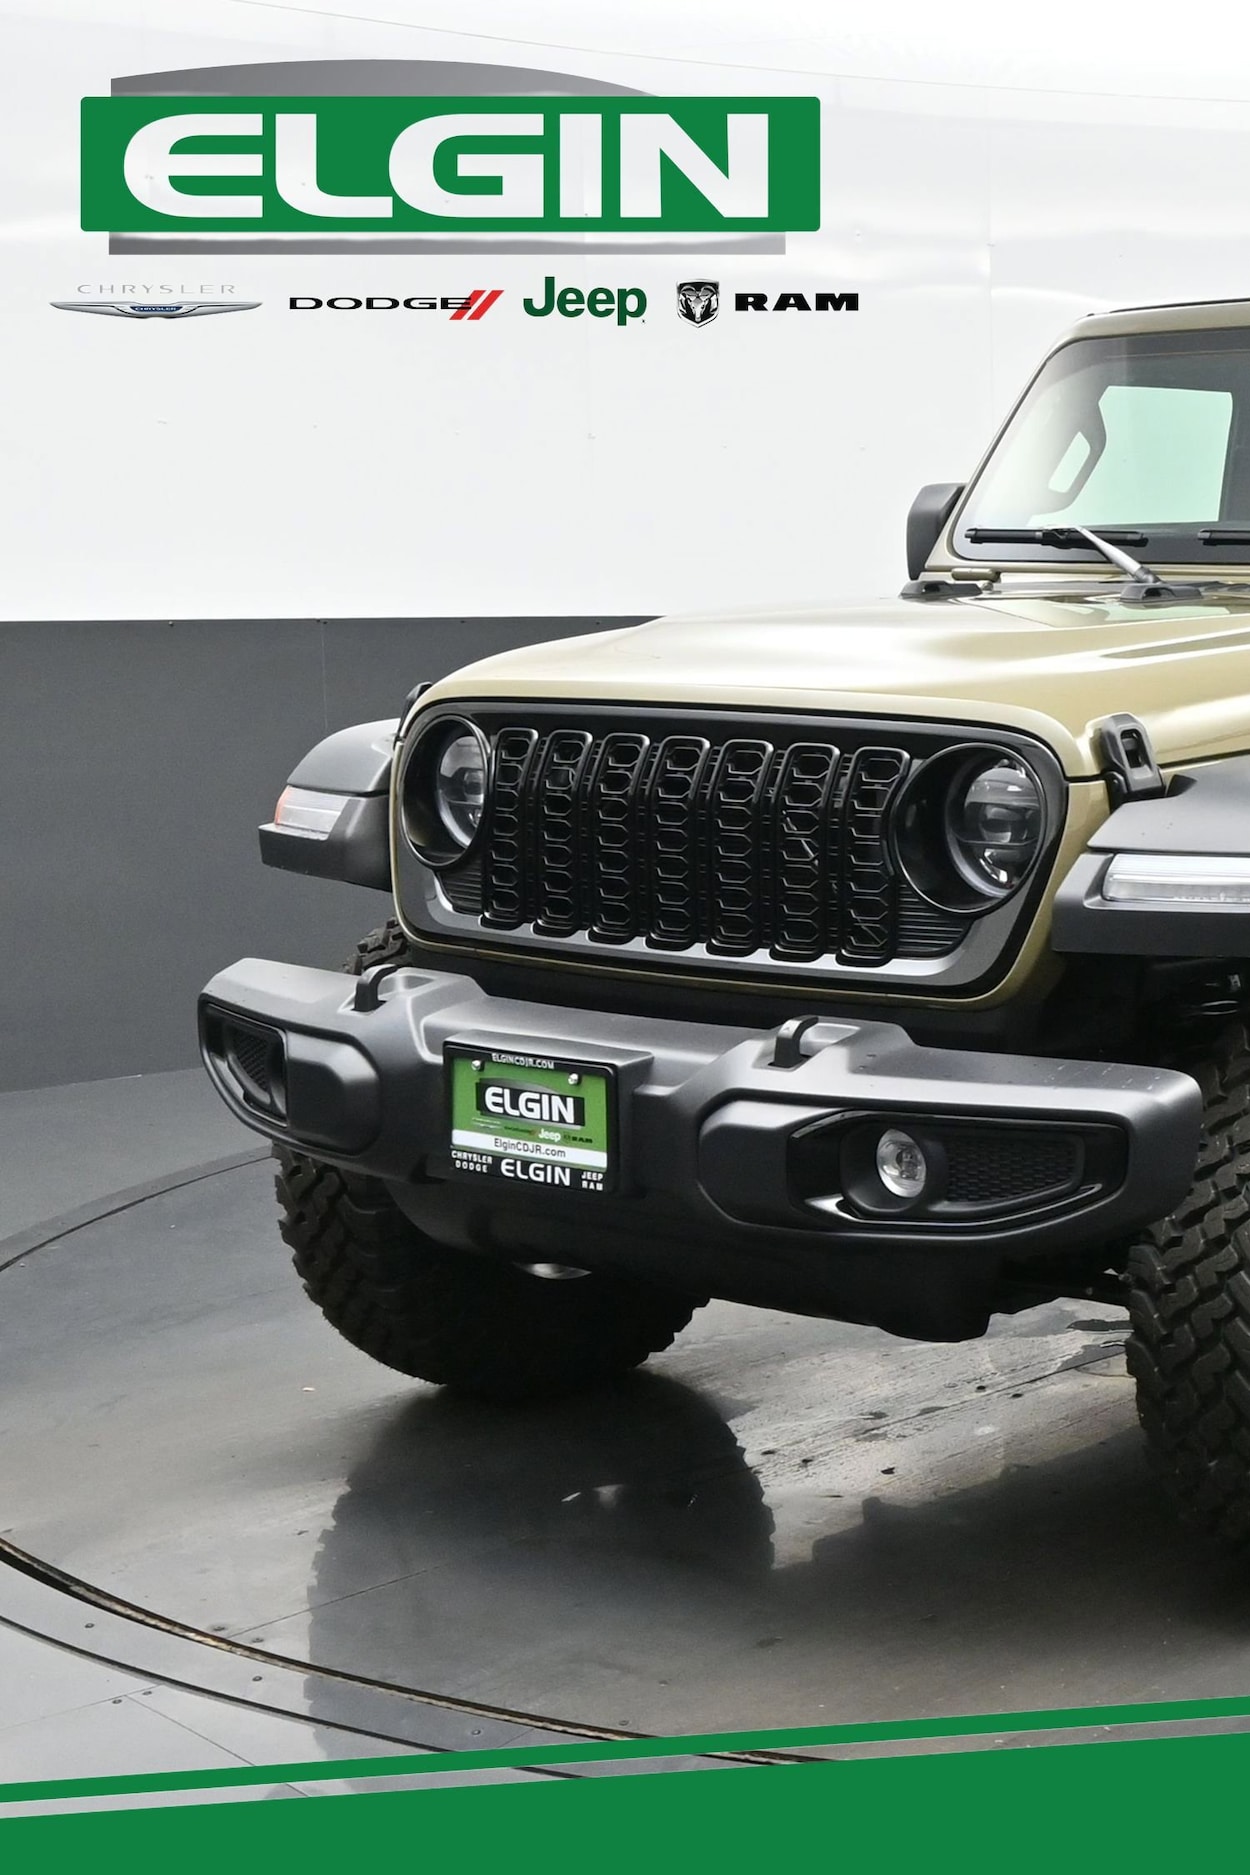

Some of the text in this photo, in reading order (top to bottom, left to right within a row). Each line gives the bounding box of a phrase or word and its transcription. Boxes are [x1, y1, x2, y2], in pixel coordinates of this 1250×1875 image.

[492, 1053, 554, 1070] ELGINCDJR.COM
[485, 1086, 574, 1123] ELGIN
[538, 1128, 561, 1142] Jeep
[494, 1138, 566, 1158] ElginCDJR.com
[452, 1150, 492, 1164] CHRYSLER
[455, 1161, 488, 1173] DODGE
[500, 1159, 570, 1186] ELGIN
[581, 1172, 603, 1181] JEEP
[582, 1182, 603, 1191] RAM
